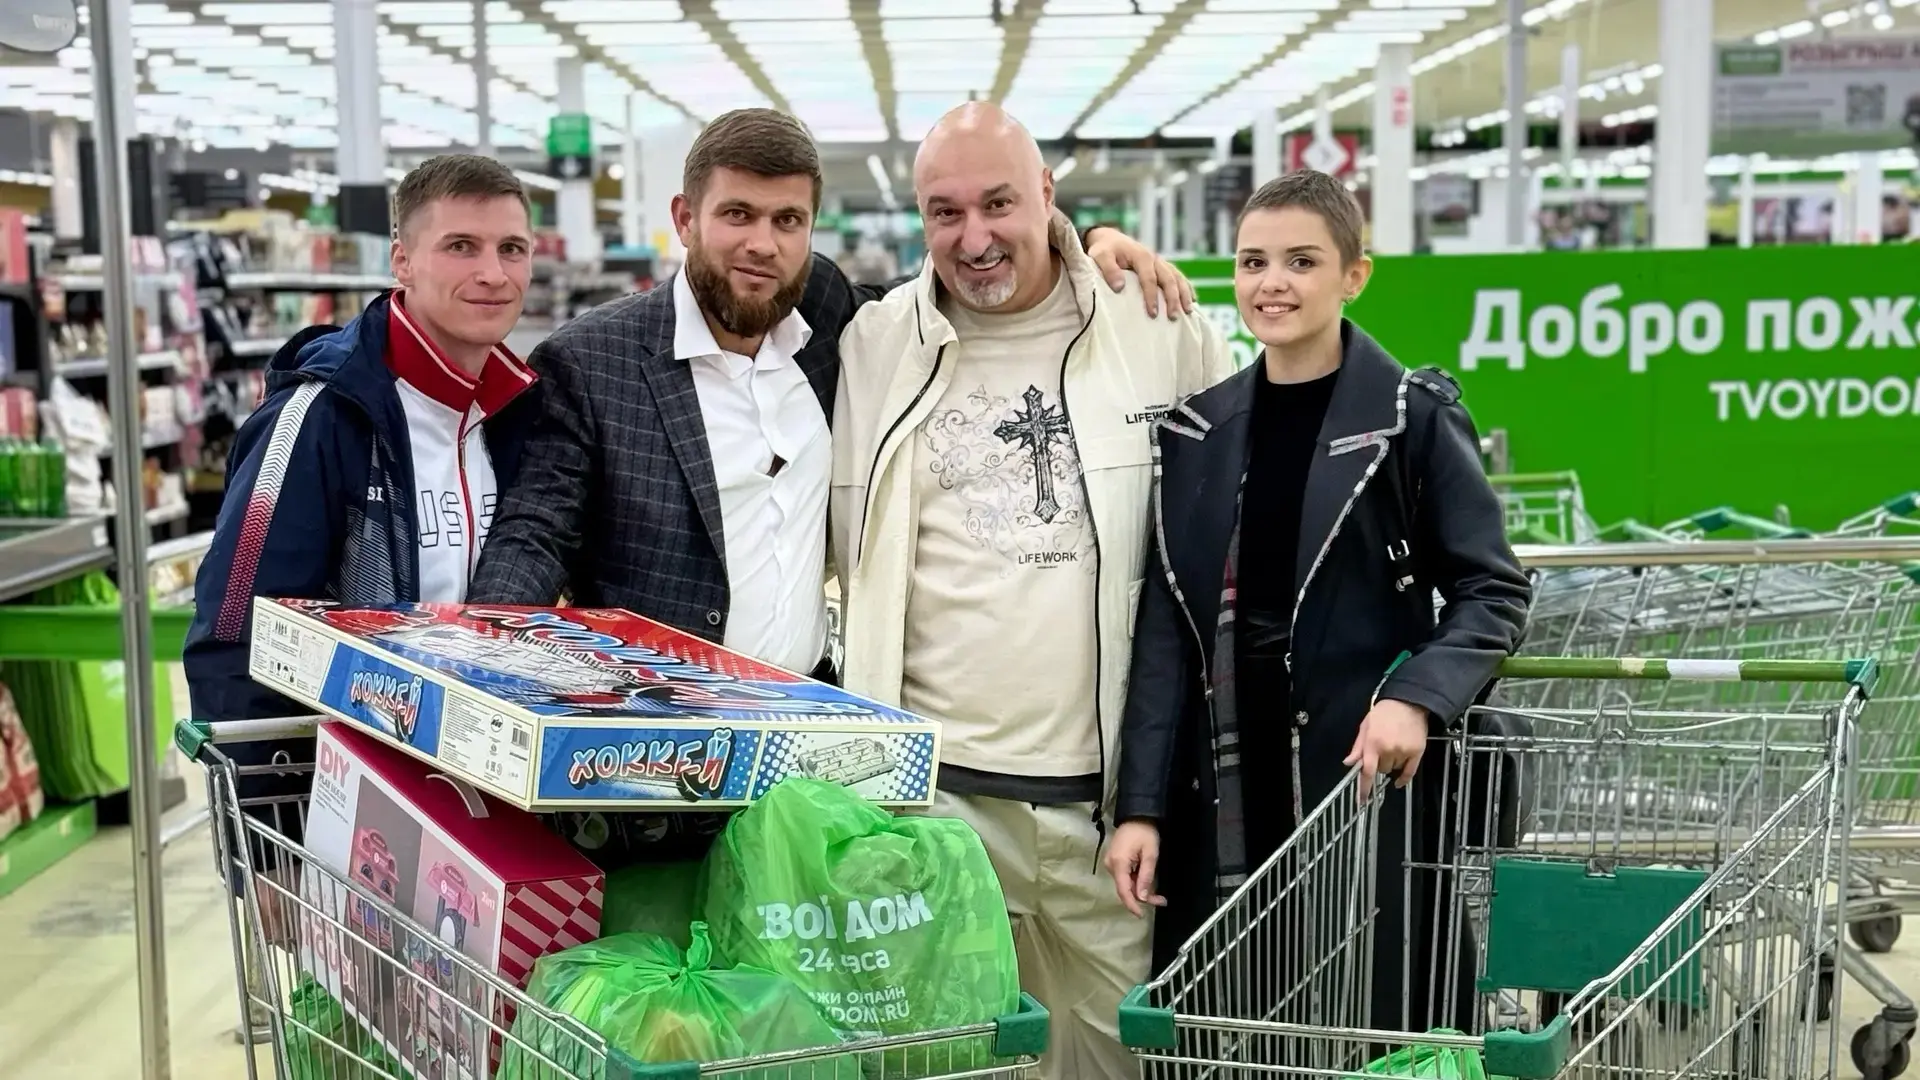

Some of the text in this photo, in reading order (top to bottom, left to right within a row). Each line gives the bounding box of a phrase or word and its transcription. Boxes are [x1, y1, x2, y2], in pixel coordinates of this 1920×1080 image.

[1459, 284, 1920, 373] Добро пож
[1018, 552, 1078, 565] LIFEWORK
[350, 671, 424, 736] ХОККЕЙ
[319, 740, 351, 788] DIY
[567, 728, 734, 791] ХОККЕЙ
[844, 890, 935, 943] ДОМ
[798, 947, 835, 973] 24
[824, 1000, 911, 1024] DOM.RU
